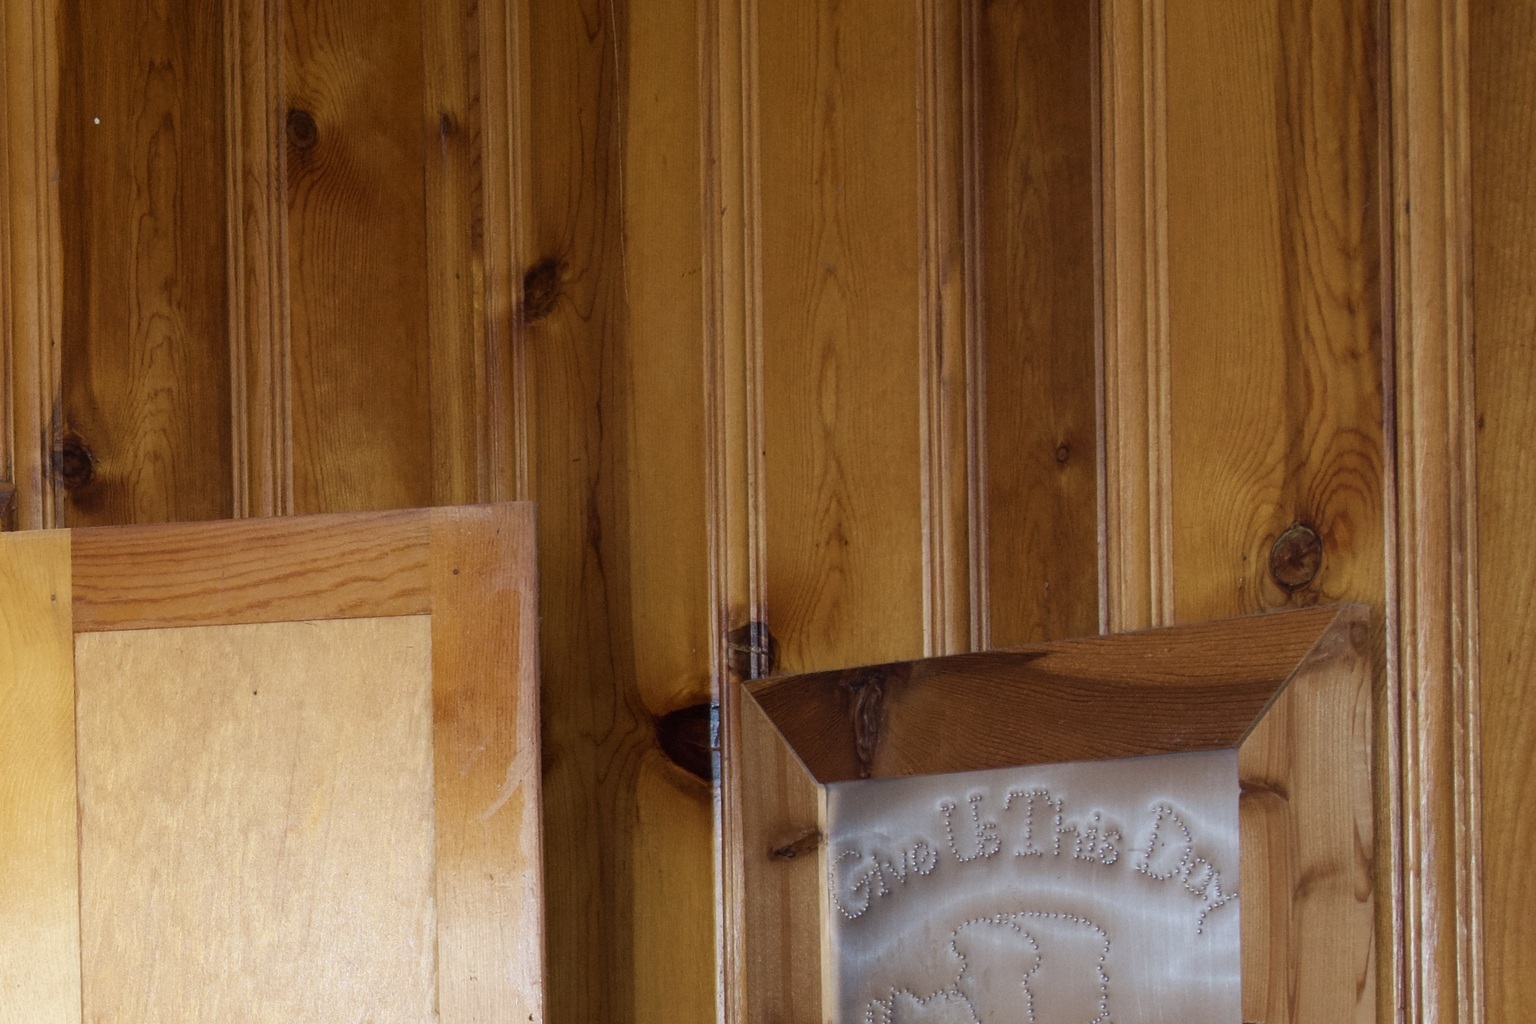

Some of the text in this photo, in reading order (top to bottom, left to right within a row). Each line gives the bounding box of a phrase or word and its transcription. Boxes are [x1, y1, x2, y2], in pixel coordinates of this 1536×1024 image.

[828, 788, 1239, 936] Give Us This Day
